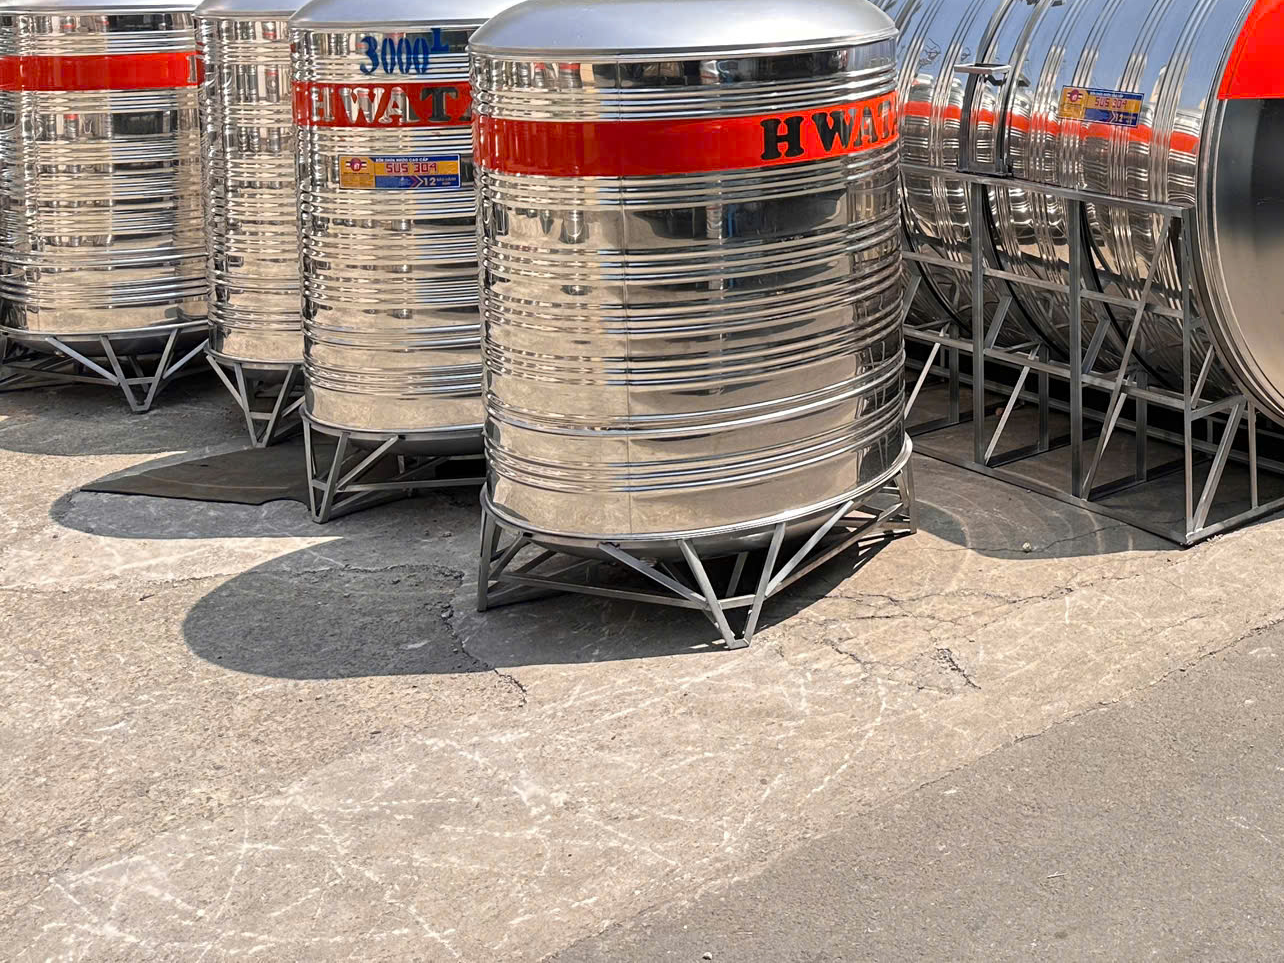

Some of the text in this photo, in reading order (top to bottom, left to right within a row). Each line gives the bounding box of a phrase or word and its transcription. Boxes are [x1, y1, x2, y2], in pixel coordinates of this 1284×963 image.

[359, 27, 449, 75] 3000L
[385, 163, 437, 173] SUS 304
[423, 177, 436, 186] 12
